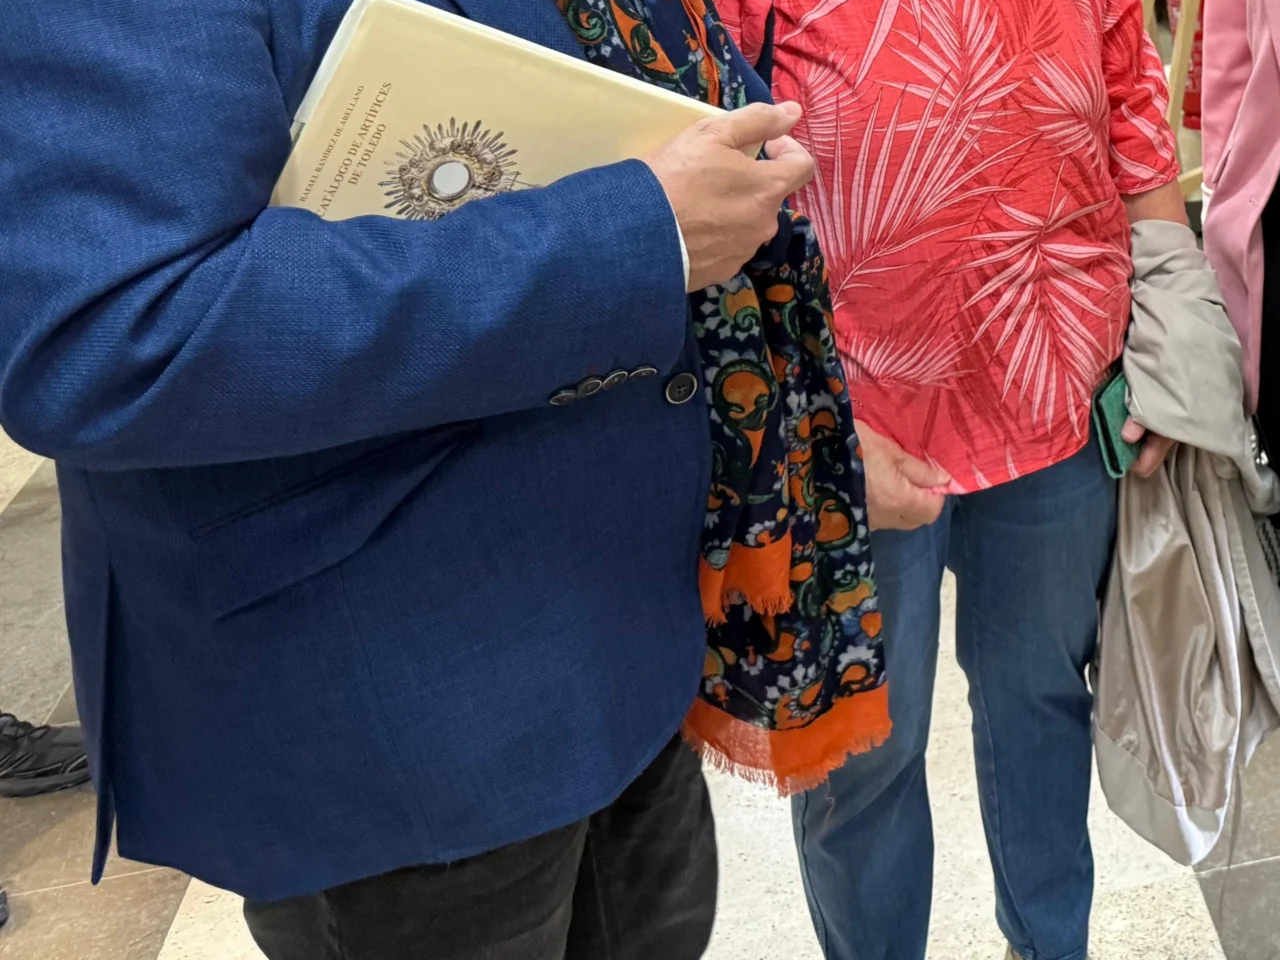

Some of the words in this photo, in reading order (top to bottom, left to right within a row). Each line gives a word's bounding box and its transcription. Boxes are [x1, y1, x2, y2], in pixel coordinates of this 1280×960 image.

[300, 174, 319, 202] RAFAEL
[315, 137, 338, 173] RAMÍREZ
[333, 126, 344, 138] DE
[340, 85, 365, 126] ARELLANO
[316, 157, 353, 217] CATÁLOGO
[347, 139, 363, 157] DE
[358, 81, 392, 141] ARTÍFICES
[348, 170, 363, 186] DE
[357, 123, 387, 168] TOLEDO
